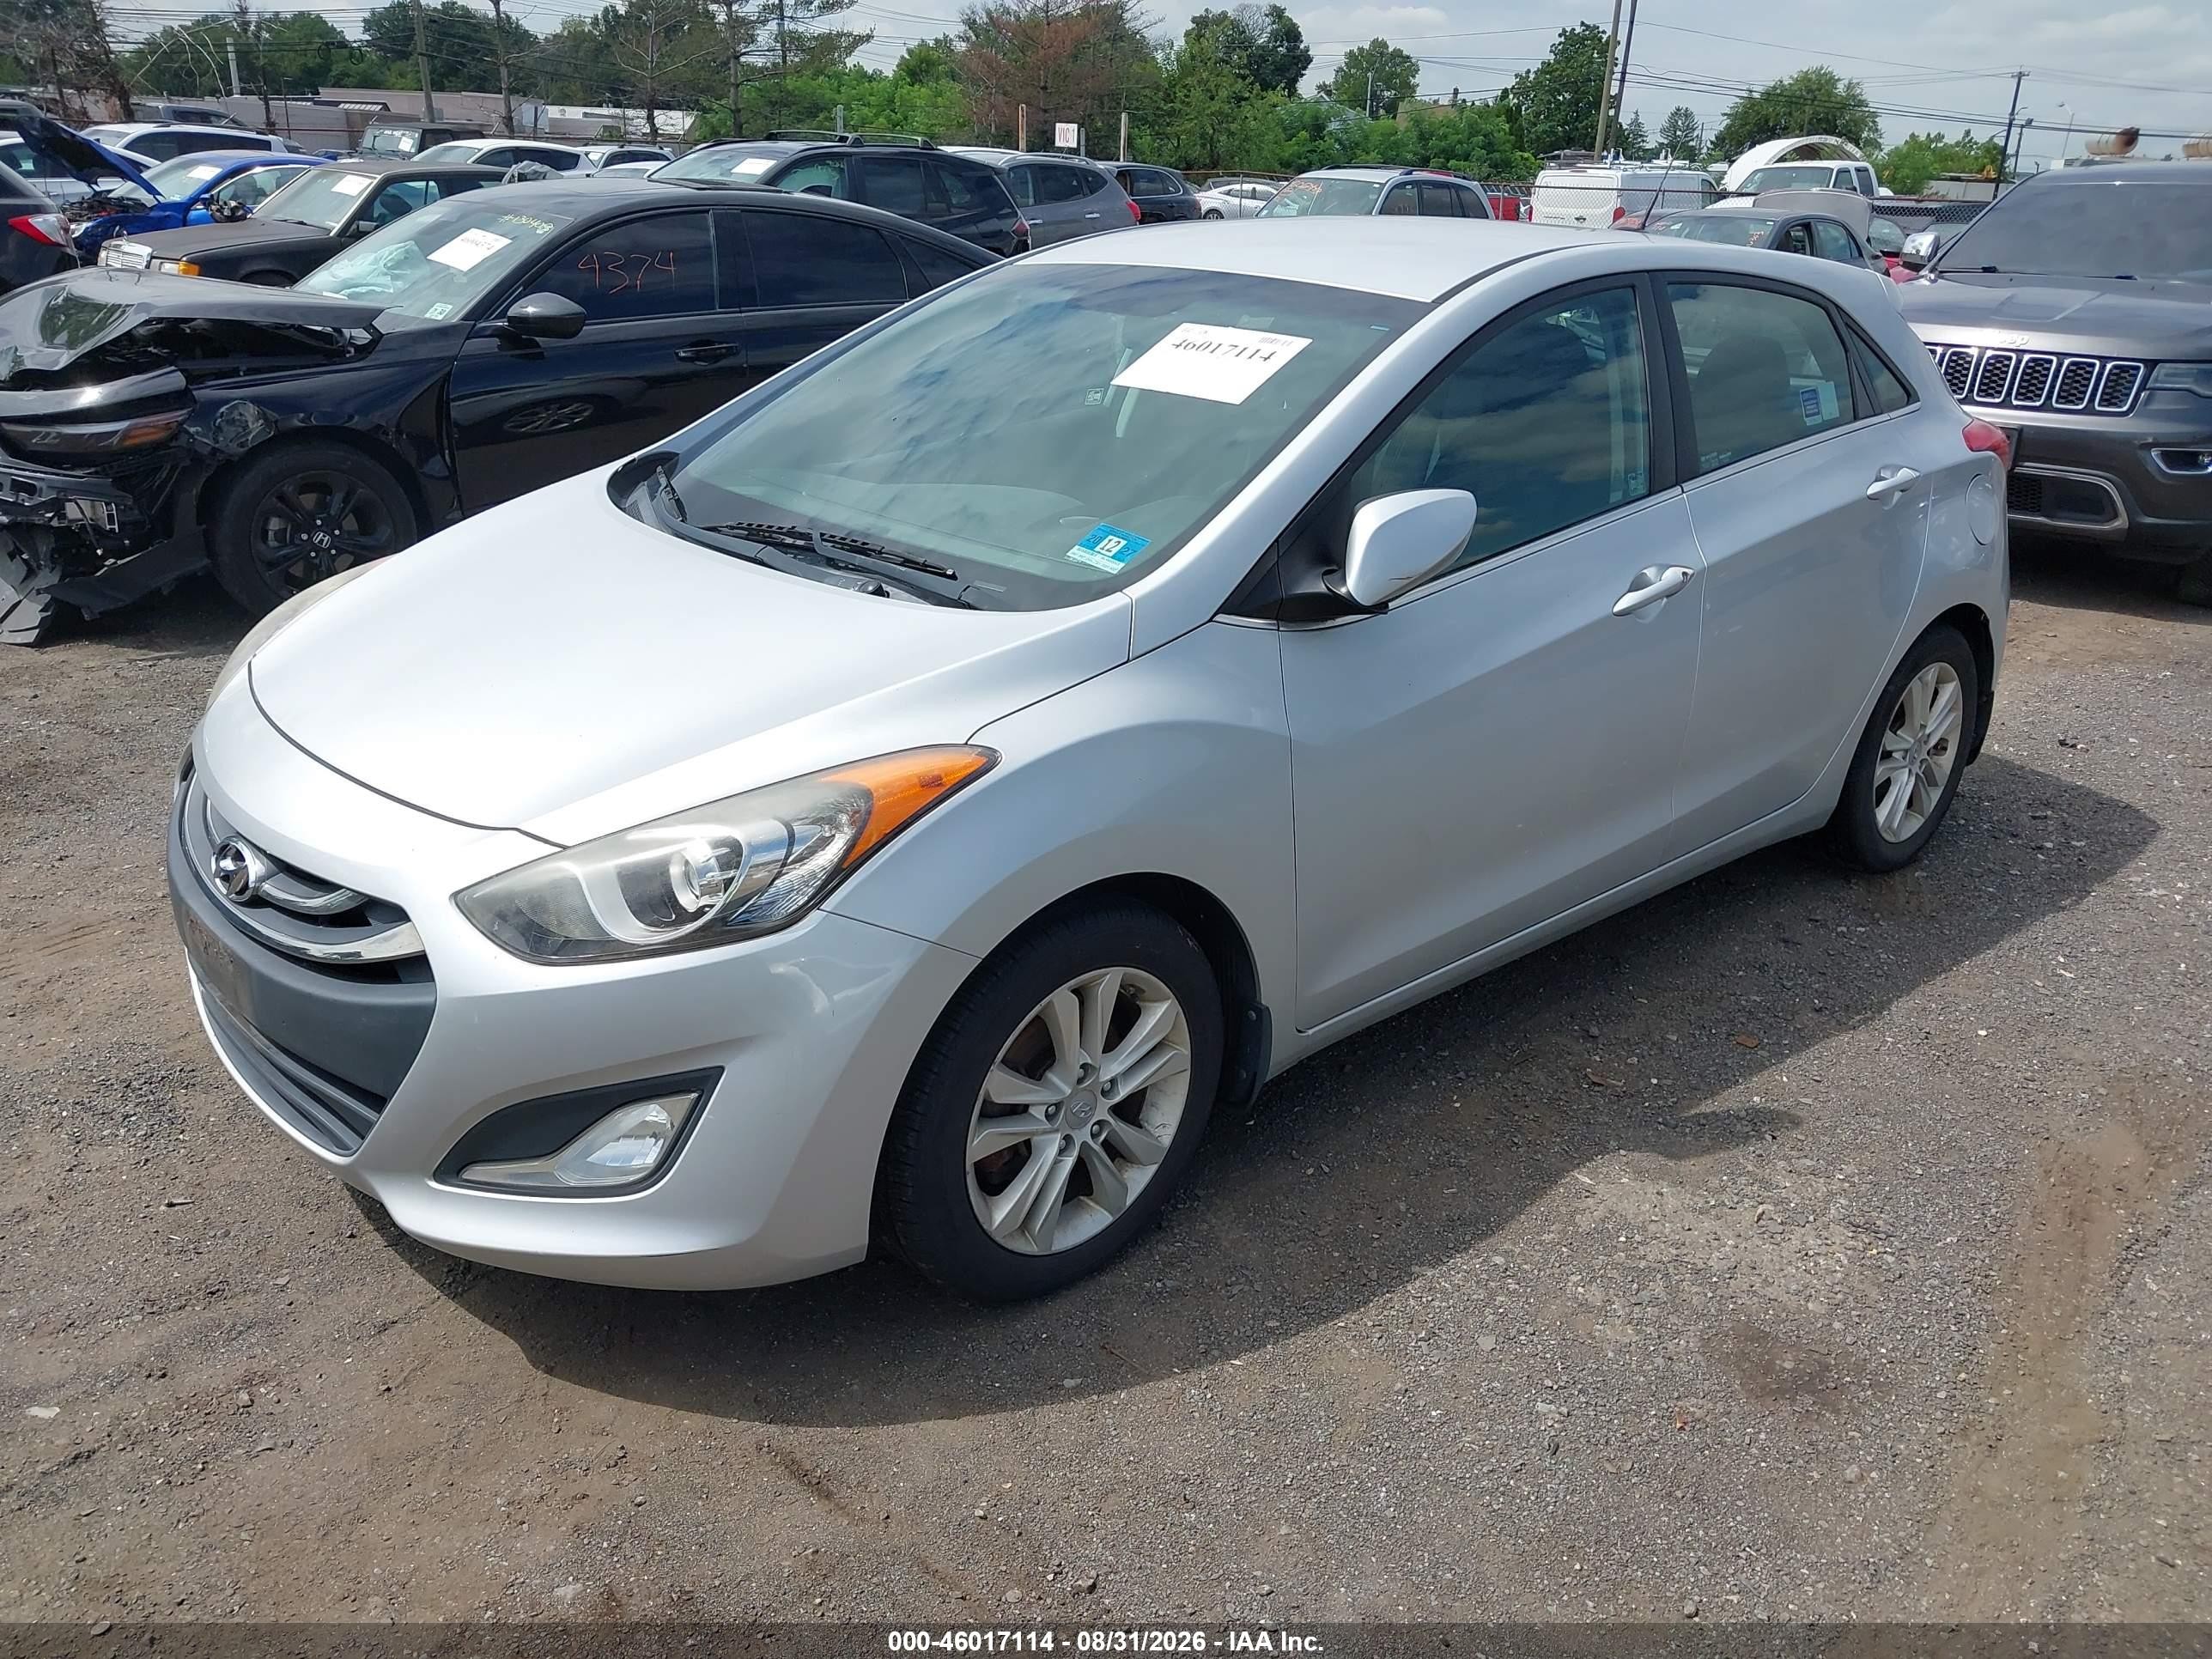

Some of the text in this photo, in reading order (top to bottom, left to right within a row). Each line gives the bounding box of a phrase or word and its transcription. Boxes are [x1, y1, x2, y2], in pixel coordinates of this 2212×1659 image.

[1058, 127, 1070, 143] VIC
[577, 248, 677, 294] 4374
[1171, 339, 1277, 362] 46017114
[1100, 538, 1122, 552] 12
